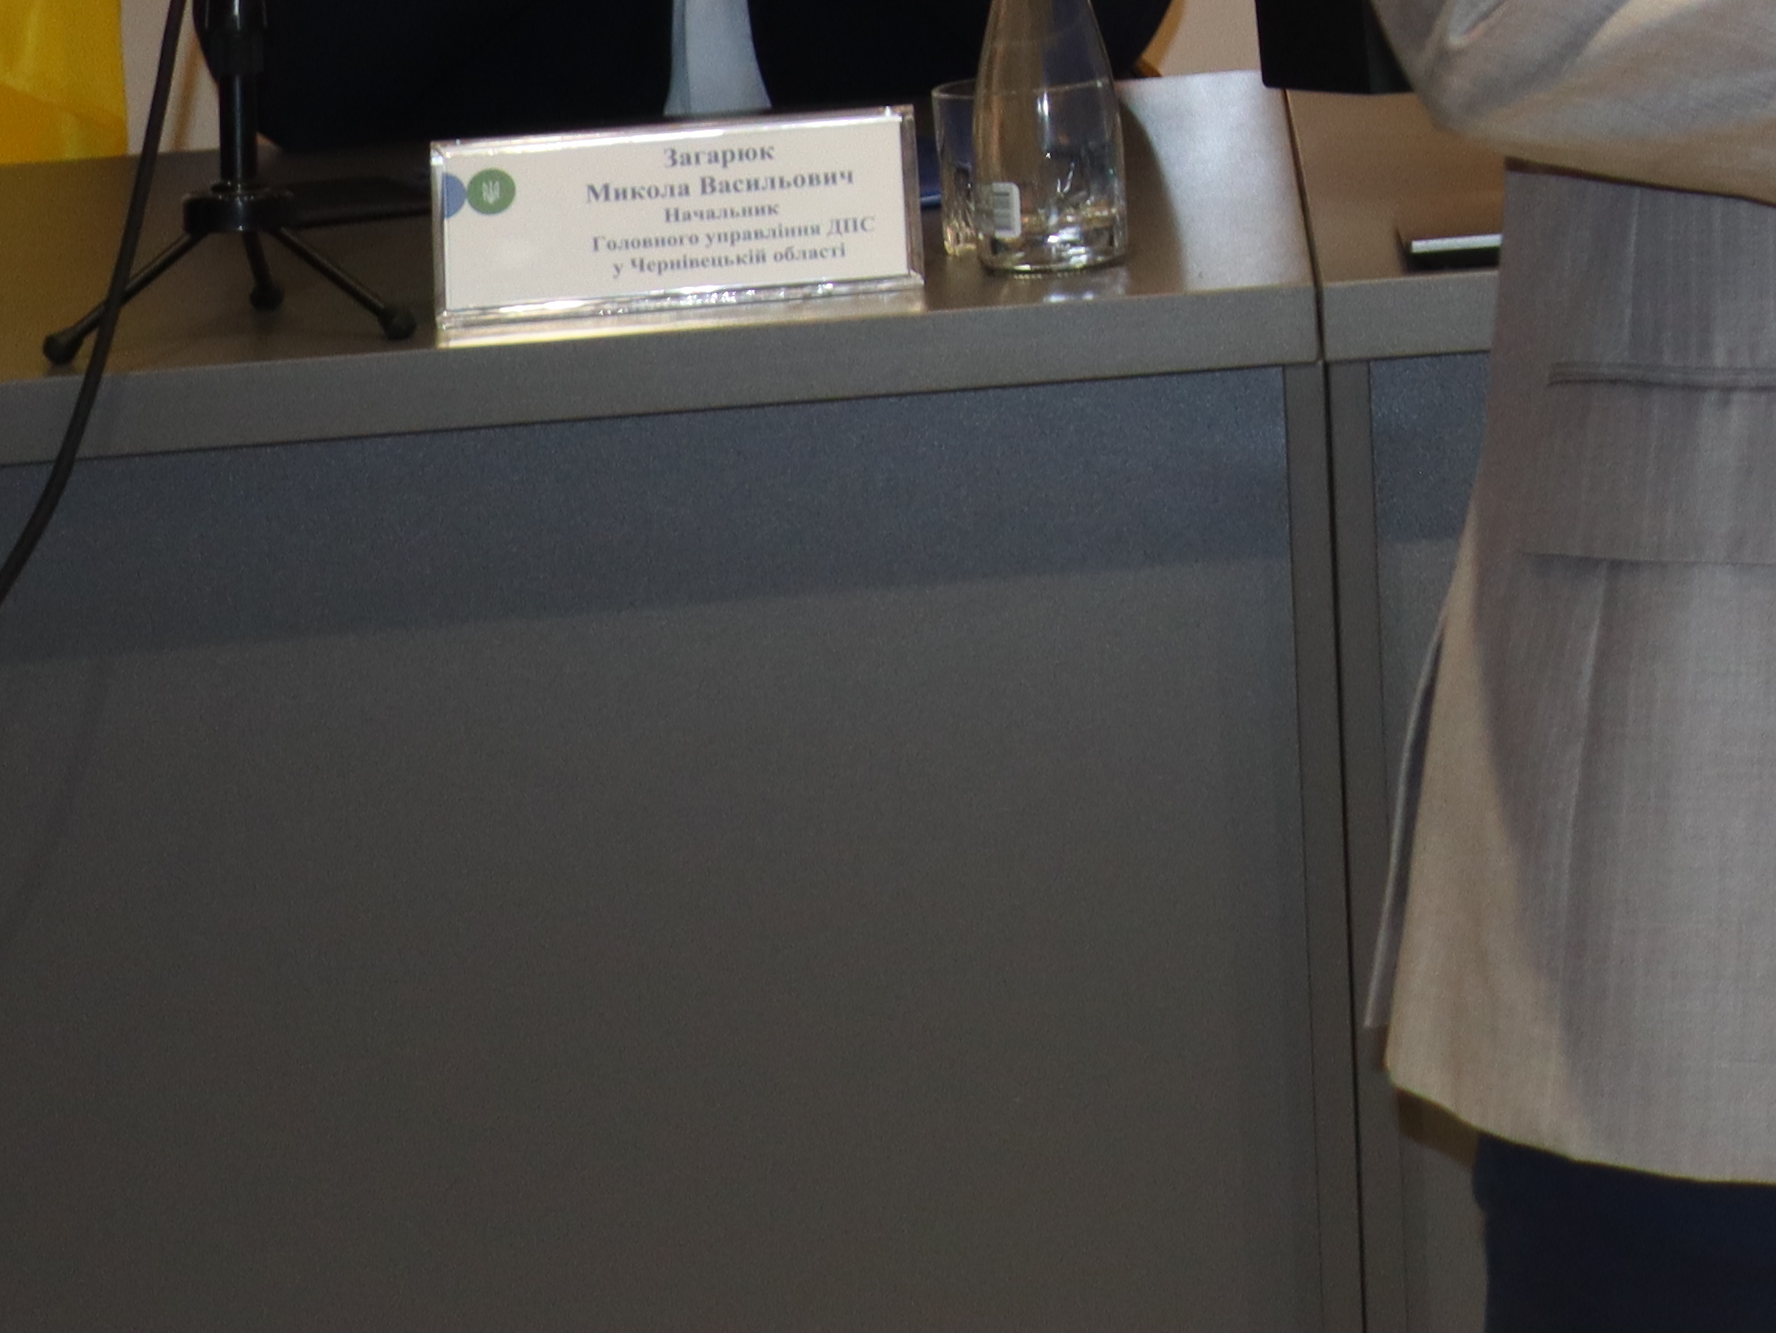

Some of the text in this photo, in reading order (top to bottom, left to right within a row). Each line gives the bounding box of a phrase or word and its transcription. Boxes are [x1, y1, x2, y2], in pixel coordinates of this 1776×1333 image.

[663, 142, 775, 169] Загарюк
[586, 168, 855, 205] Микола Васильович
[664, 202, 780, 224] Начальник
[592, 216, 876, 254] Головного управління ДПС
[612, 242, 846, 279] у Чернівецькій області
